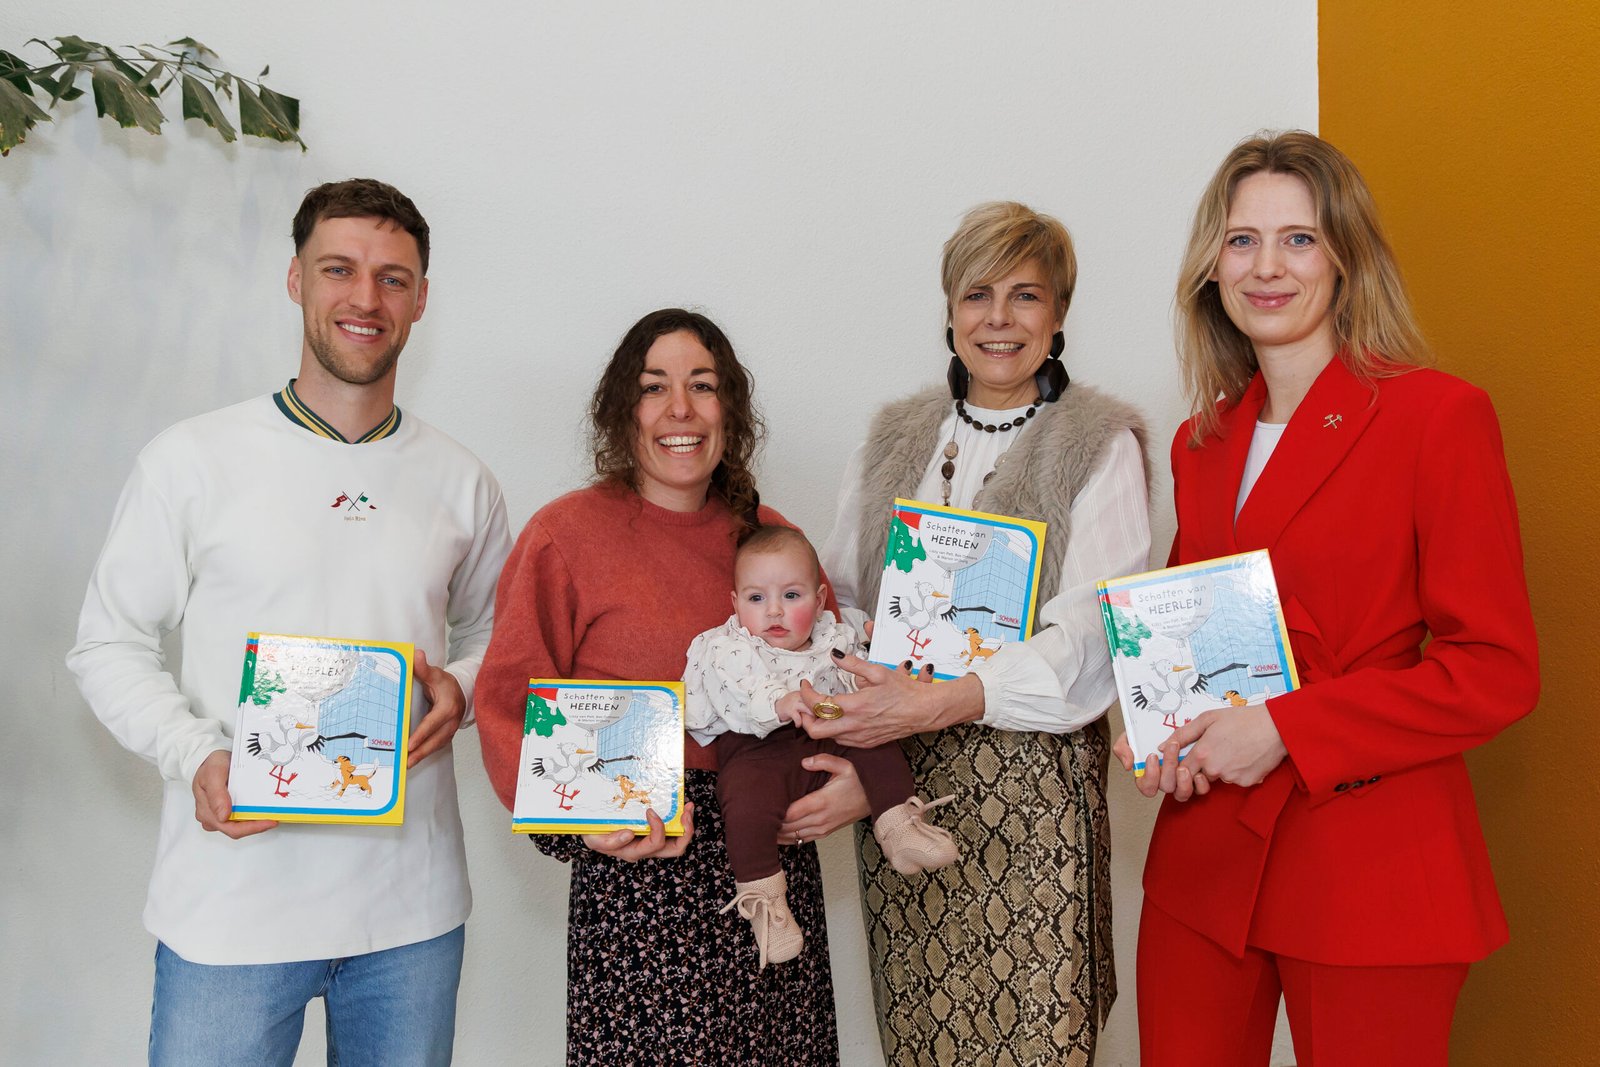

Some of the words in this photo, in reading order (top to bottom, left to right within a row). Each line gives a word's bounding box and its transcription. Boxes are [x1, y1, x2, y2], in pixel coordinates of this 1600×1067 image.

[926, 521, 966, 535] Schatten
[931, 534, 979, 550] HEERLEN
[1138, 589, 1183, 603] Schatten
[1187, 584, 1206, 594] van
[1148, 597, 1202, 615] HEERLEN
[564, 692, 605, 701] Schatten
[570, 702, 620, 711] HEERLEN
